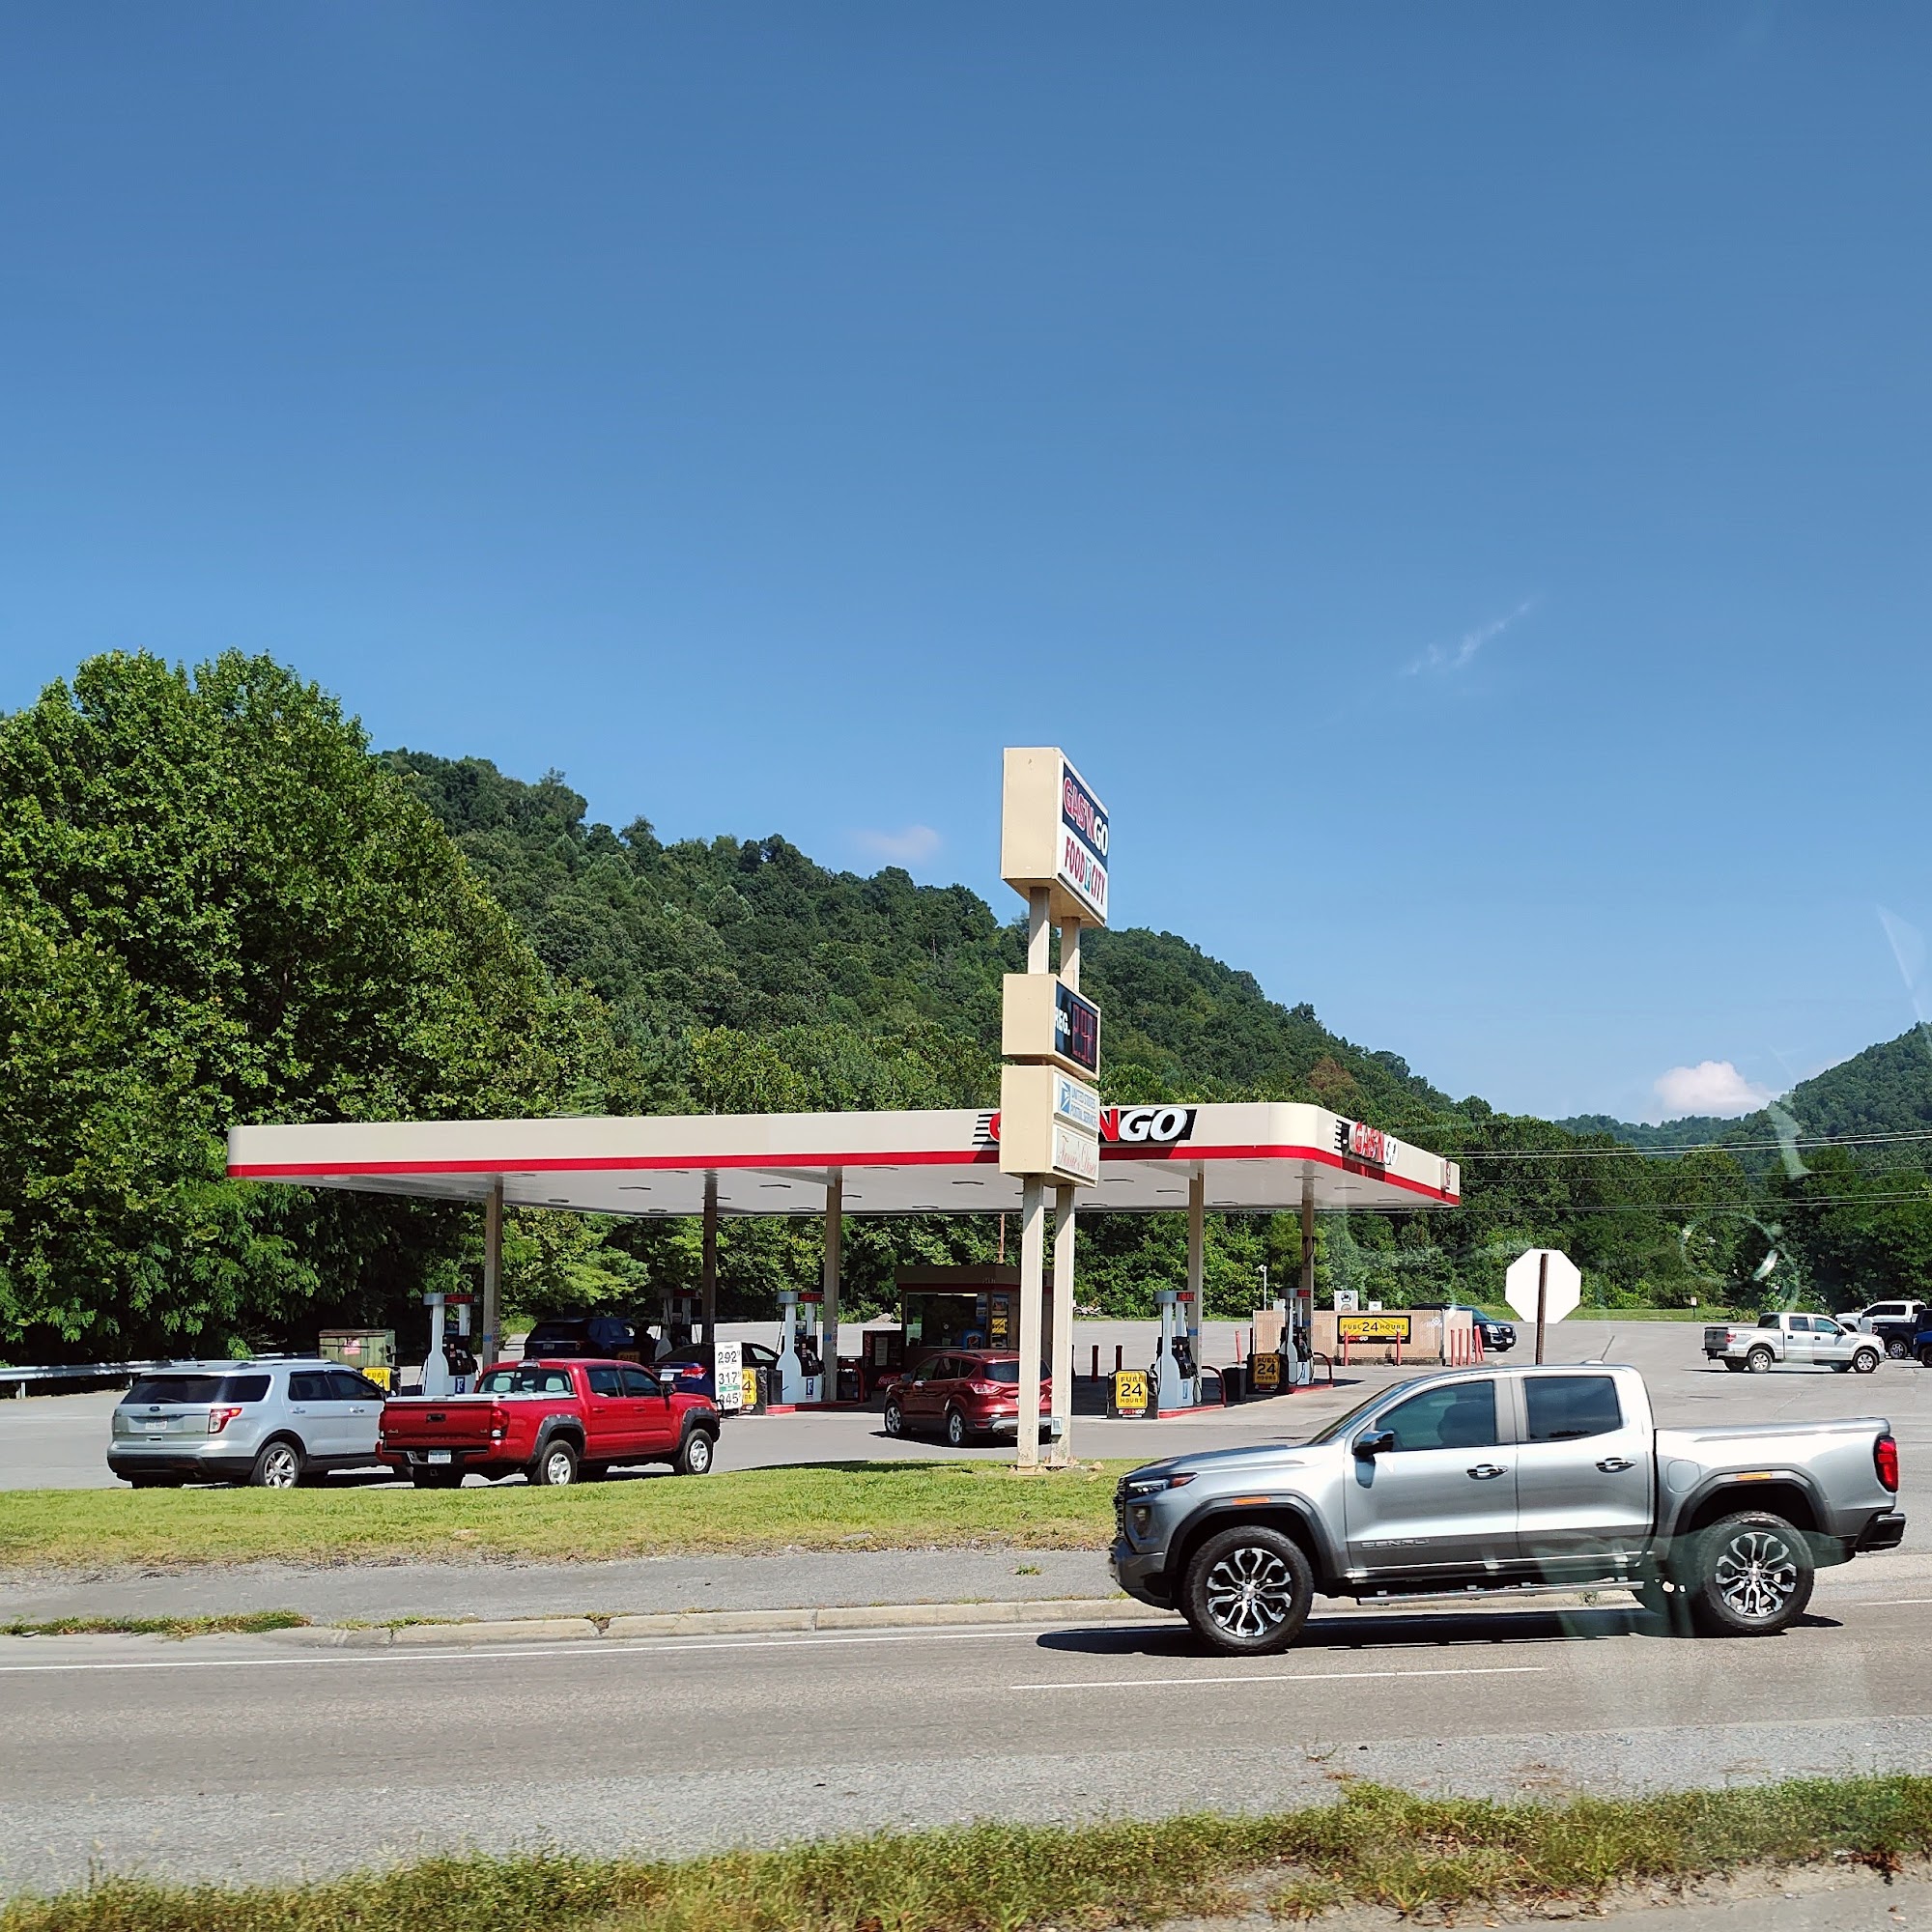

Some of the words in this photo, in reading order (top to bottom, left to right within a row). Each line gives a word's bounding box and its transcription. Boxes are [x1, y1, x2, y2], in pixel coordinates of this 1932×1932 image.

[1065, 836, 1085, 884] FOOD
[1091, 863, 1105, 905] CITY
[1362, 1321, 1378, 1332] 24
[1257, 1363, 1276, 1375] 24
[1121, 1382, 1143, 1397] 24
